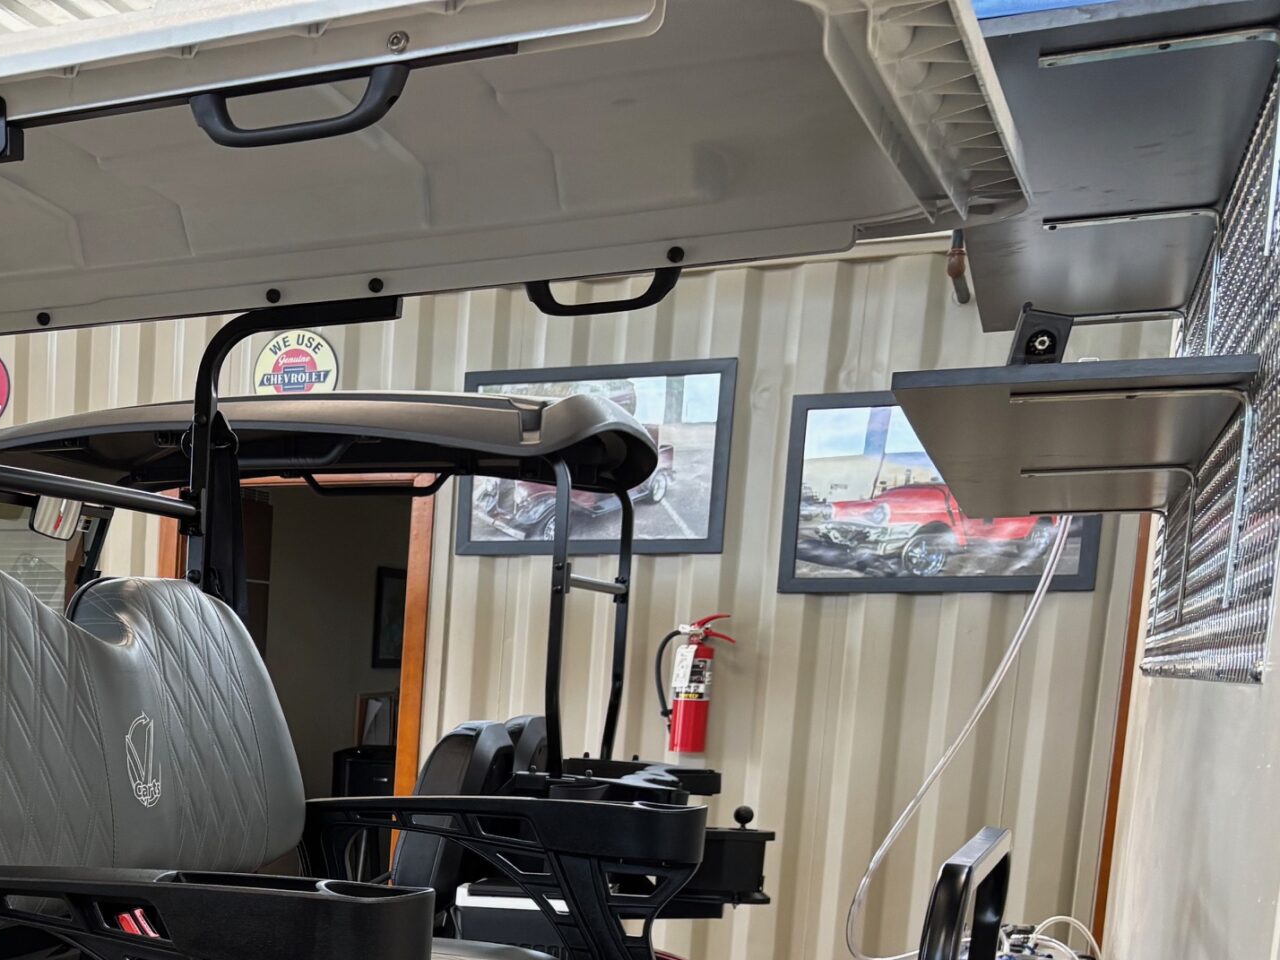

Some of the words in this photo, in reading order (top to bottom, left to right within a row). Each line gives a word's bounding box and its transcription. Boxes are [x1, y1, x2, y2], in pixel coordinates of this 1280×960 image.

[269, 336, 291, 356] WE
[296, 333, 324, 355] USE
[278, 354, 311, 366] Genuine
[263, 371, 326, 385] CHEVROLET
